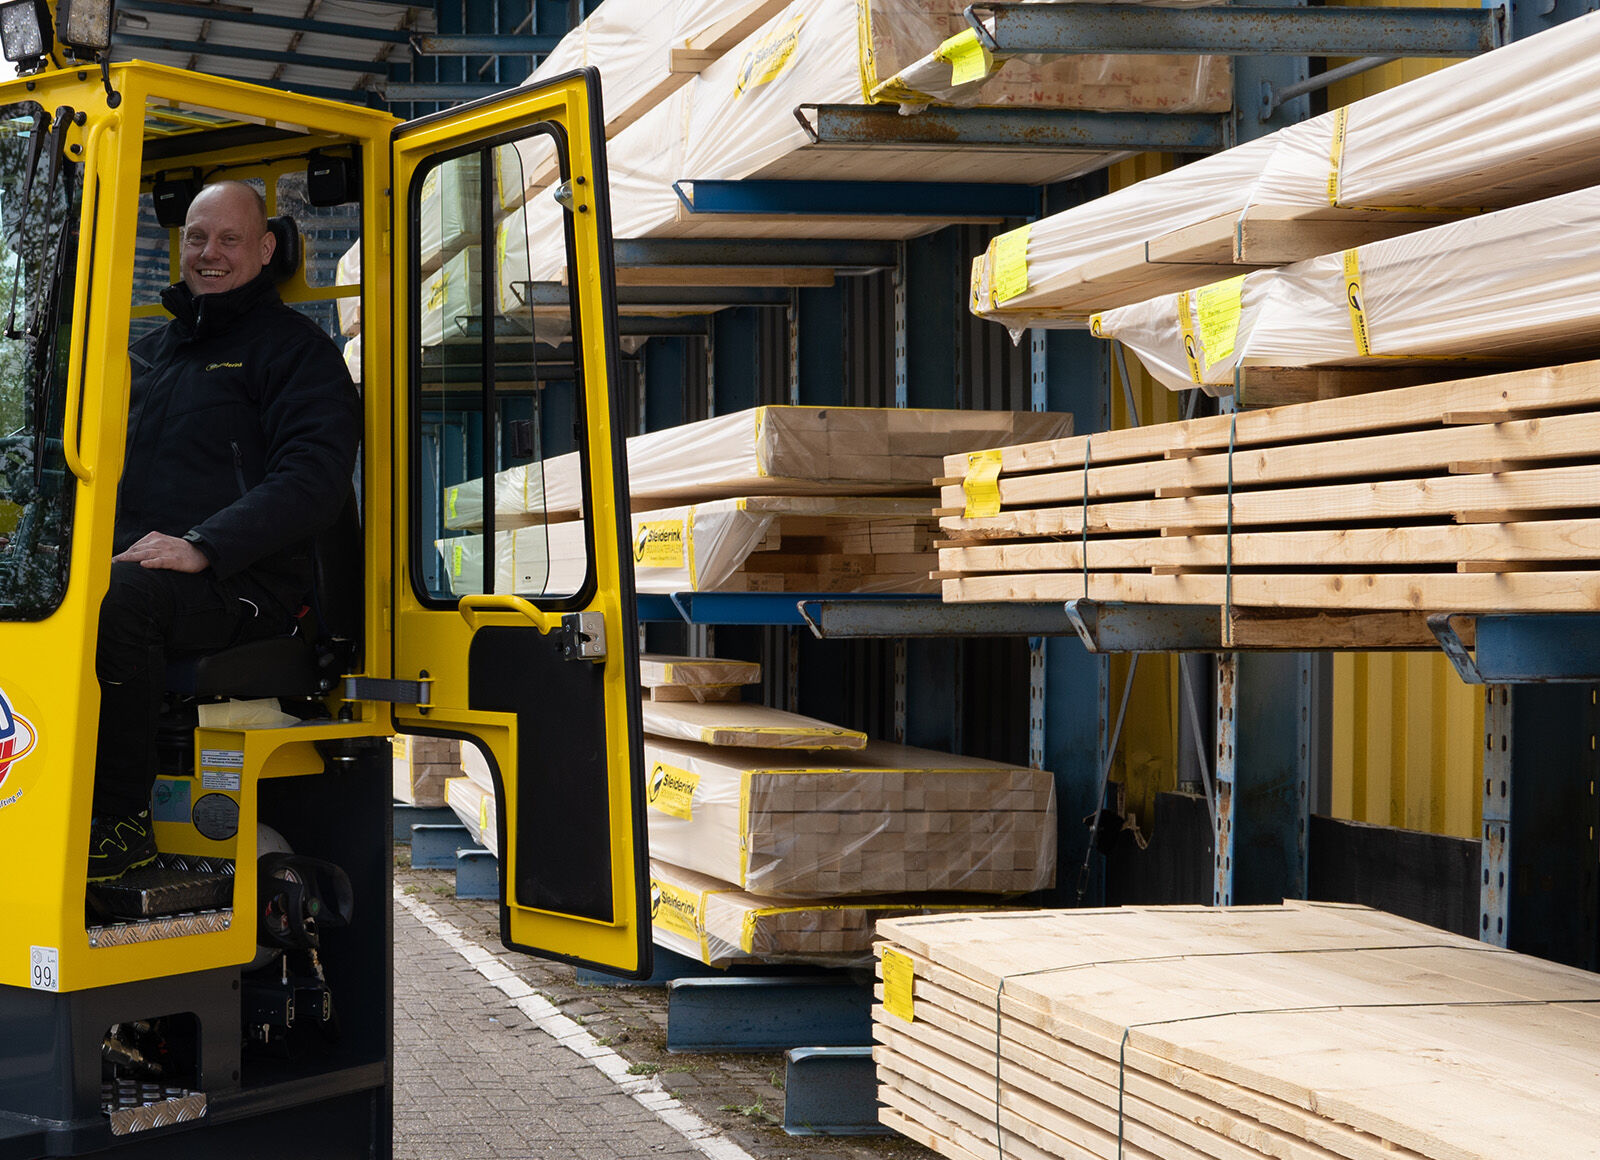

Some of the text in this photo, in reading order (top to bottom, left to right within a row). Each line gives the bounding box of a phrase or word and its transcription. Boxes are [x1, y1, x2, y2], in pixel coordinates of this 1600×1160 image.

[647, 528, 681, 543] Sleiderink
[663, 773, 696, 796] Sleiderink
[661, 890, 696, 915] Sleiderink
[34, 965, 52, 987] 99
